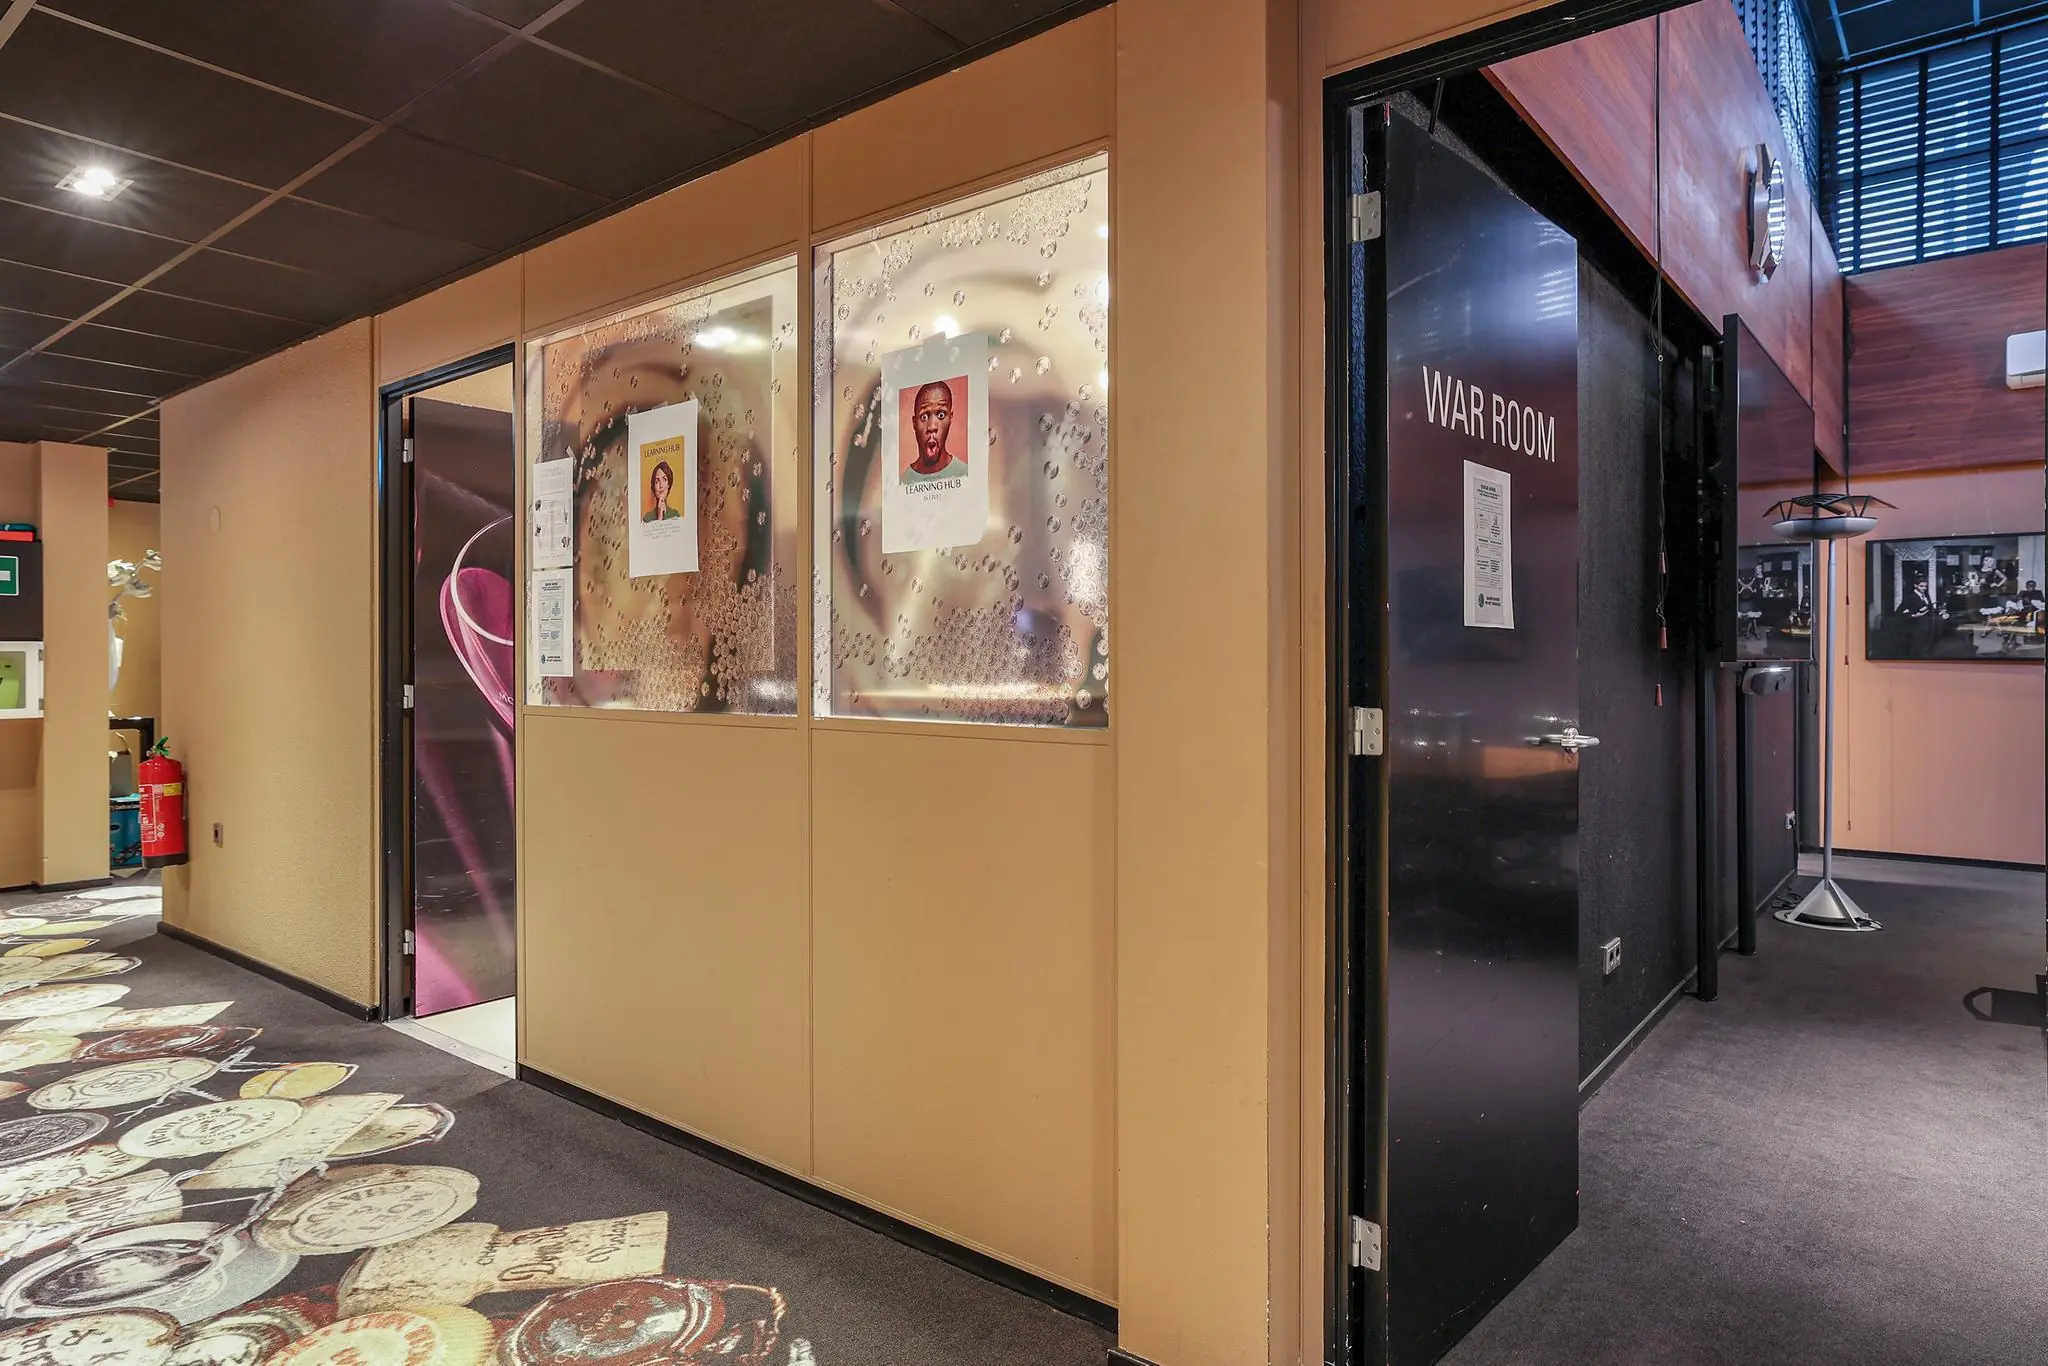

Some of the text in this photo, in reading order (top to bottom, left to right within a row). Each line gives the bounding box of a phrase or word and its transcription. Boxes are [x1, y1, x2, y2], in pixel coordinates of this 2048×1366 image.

[1422, 365, 1555, 463] WAR ROOM
[644, 444, 681, 458] LEARNING HUB
[905, 479, 961, 494] LEARNING HUB
